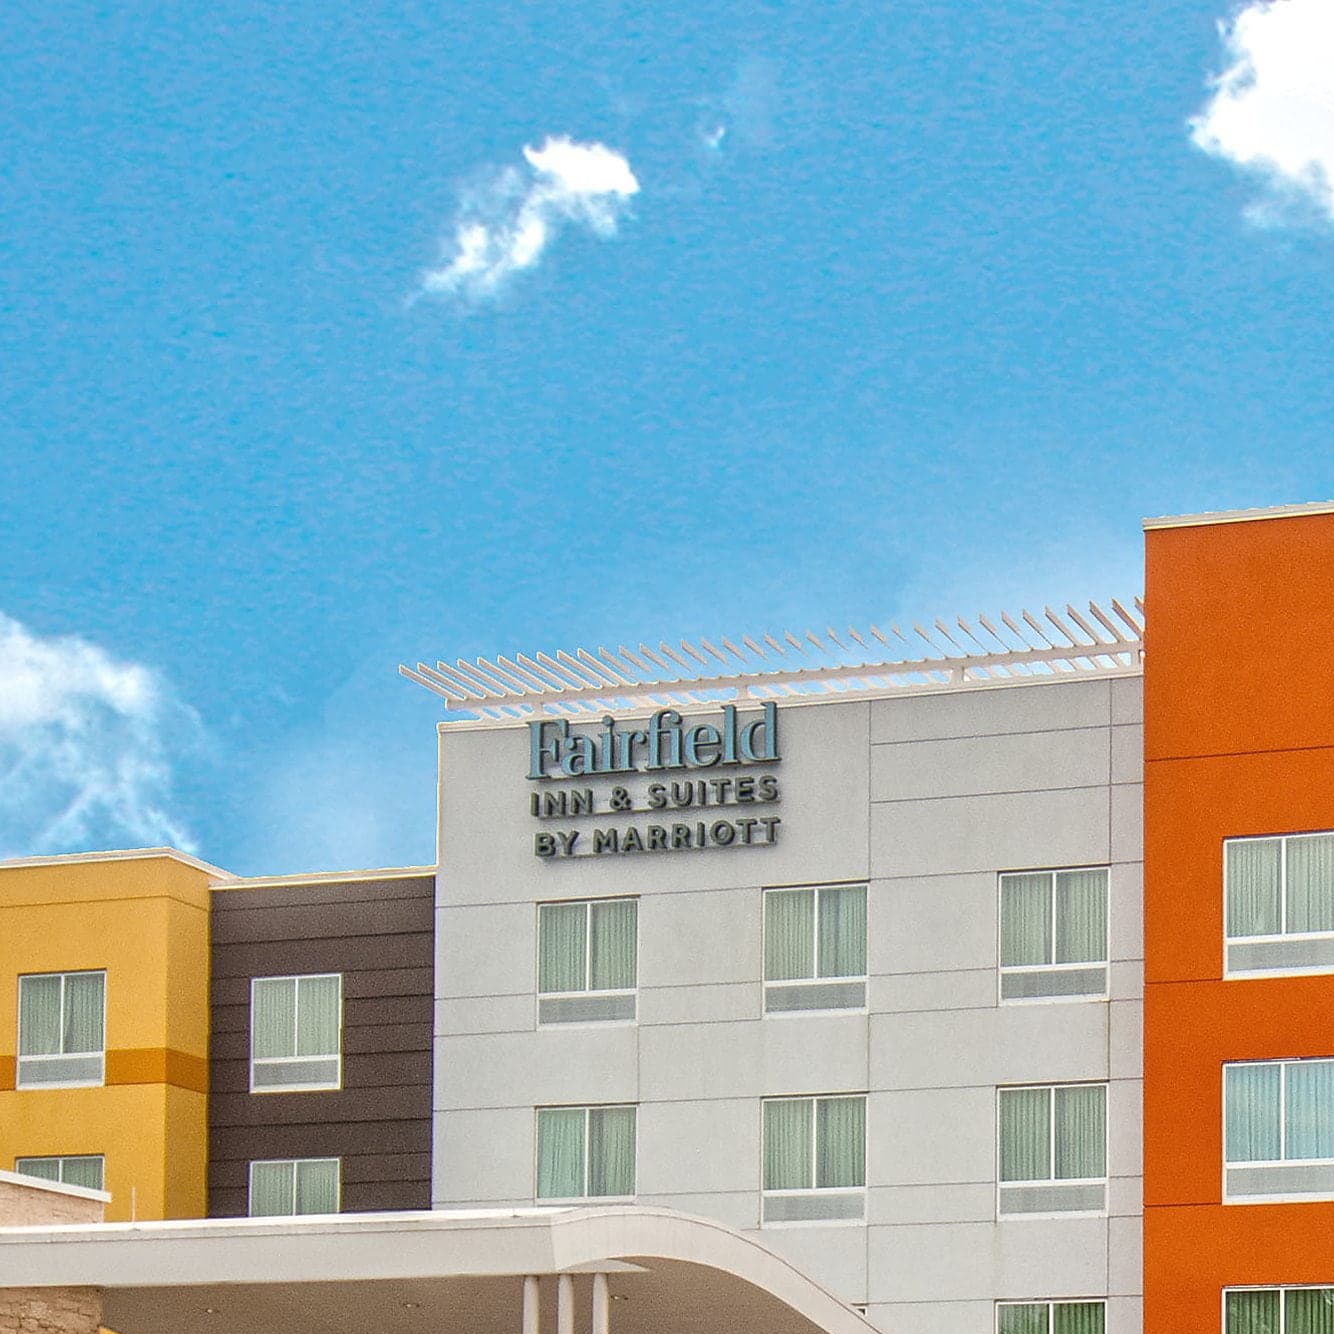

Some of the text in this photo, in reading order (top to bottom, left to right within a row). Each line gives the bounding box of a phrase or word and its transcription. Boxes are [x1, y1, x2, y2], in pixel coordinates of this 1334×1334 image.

[525, 701, 782, 780] Fairfield
[530, 774, 779, 817] INN & SUITES
[534, 816, 782, 857] BY MARRIOTT
